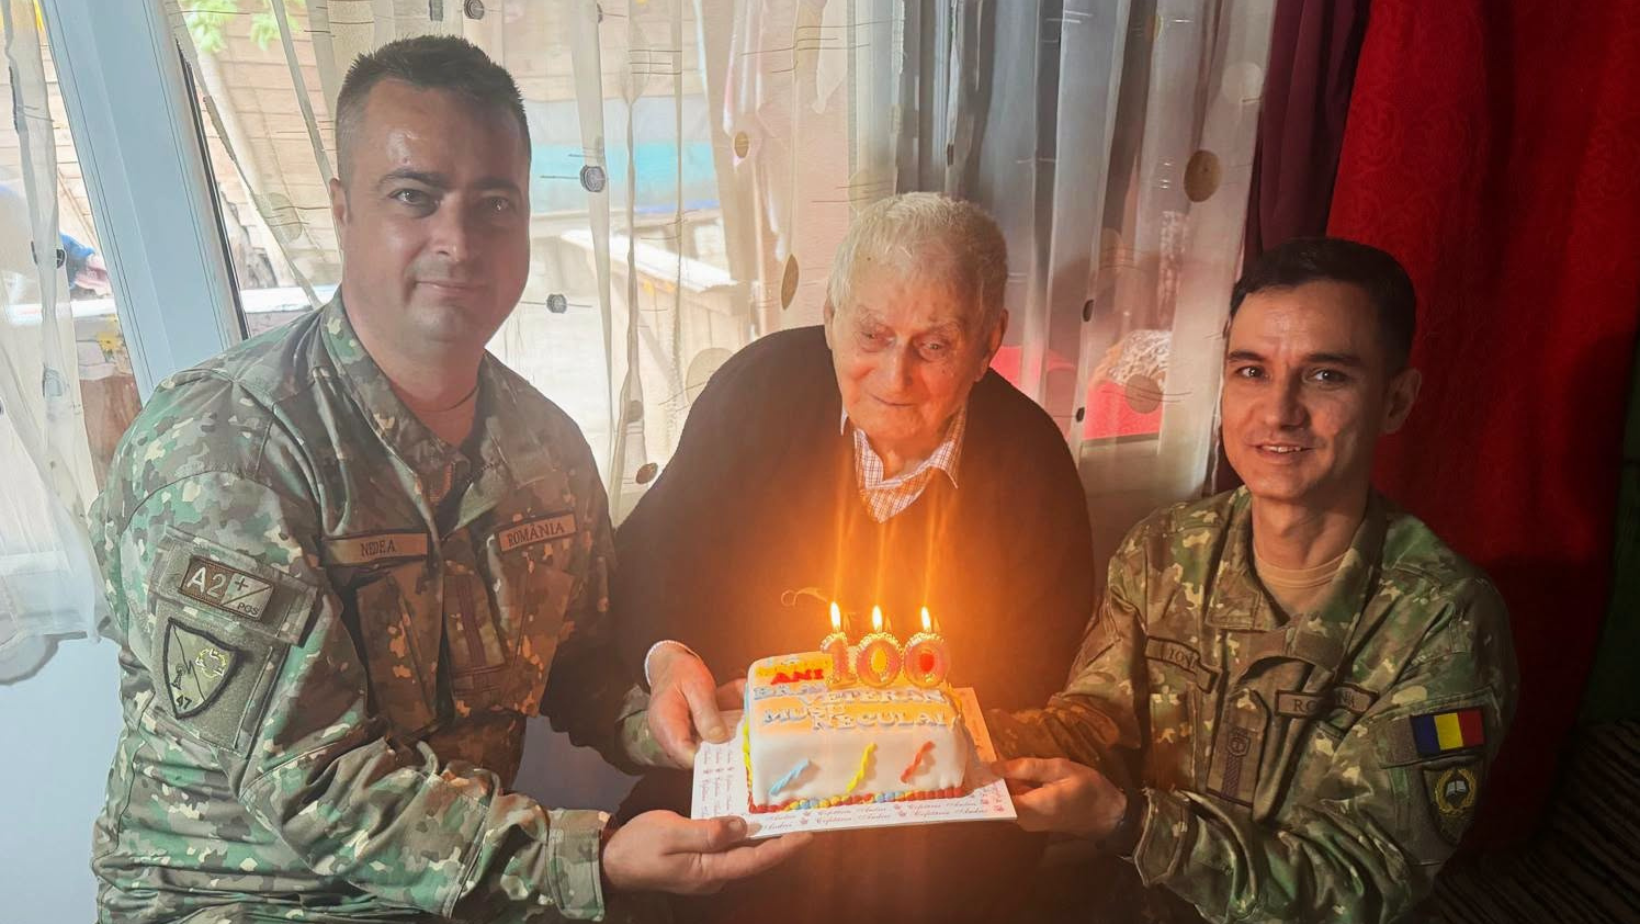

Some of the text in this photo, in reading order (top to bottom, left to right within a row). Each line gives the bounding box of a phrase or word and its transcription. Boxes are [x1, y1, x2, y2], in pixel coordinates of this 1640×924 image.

[508, 521, 565, 547] ROMÂNIA
[186, 566, 227, 598] A2
[820, 630, 950, 690] 100
[770, 669, 824, 686] ANI
